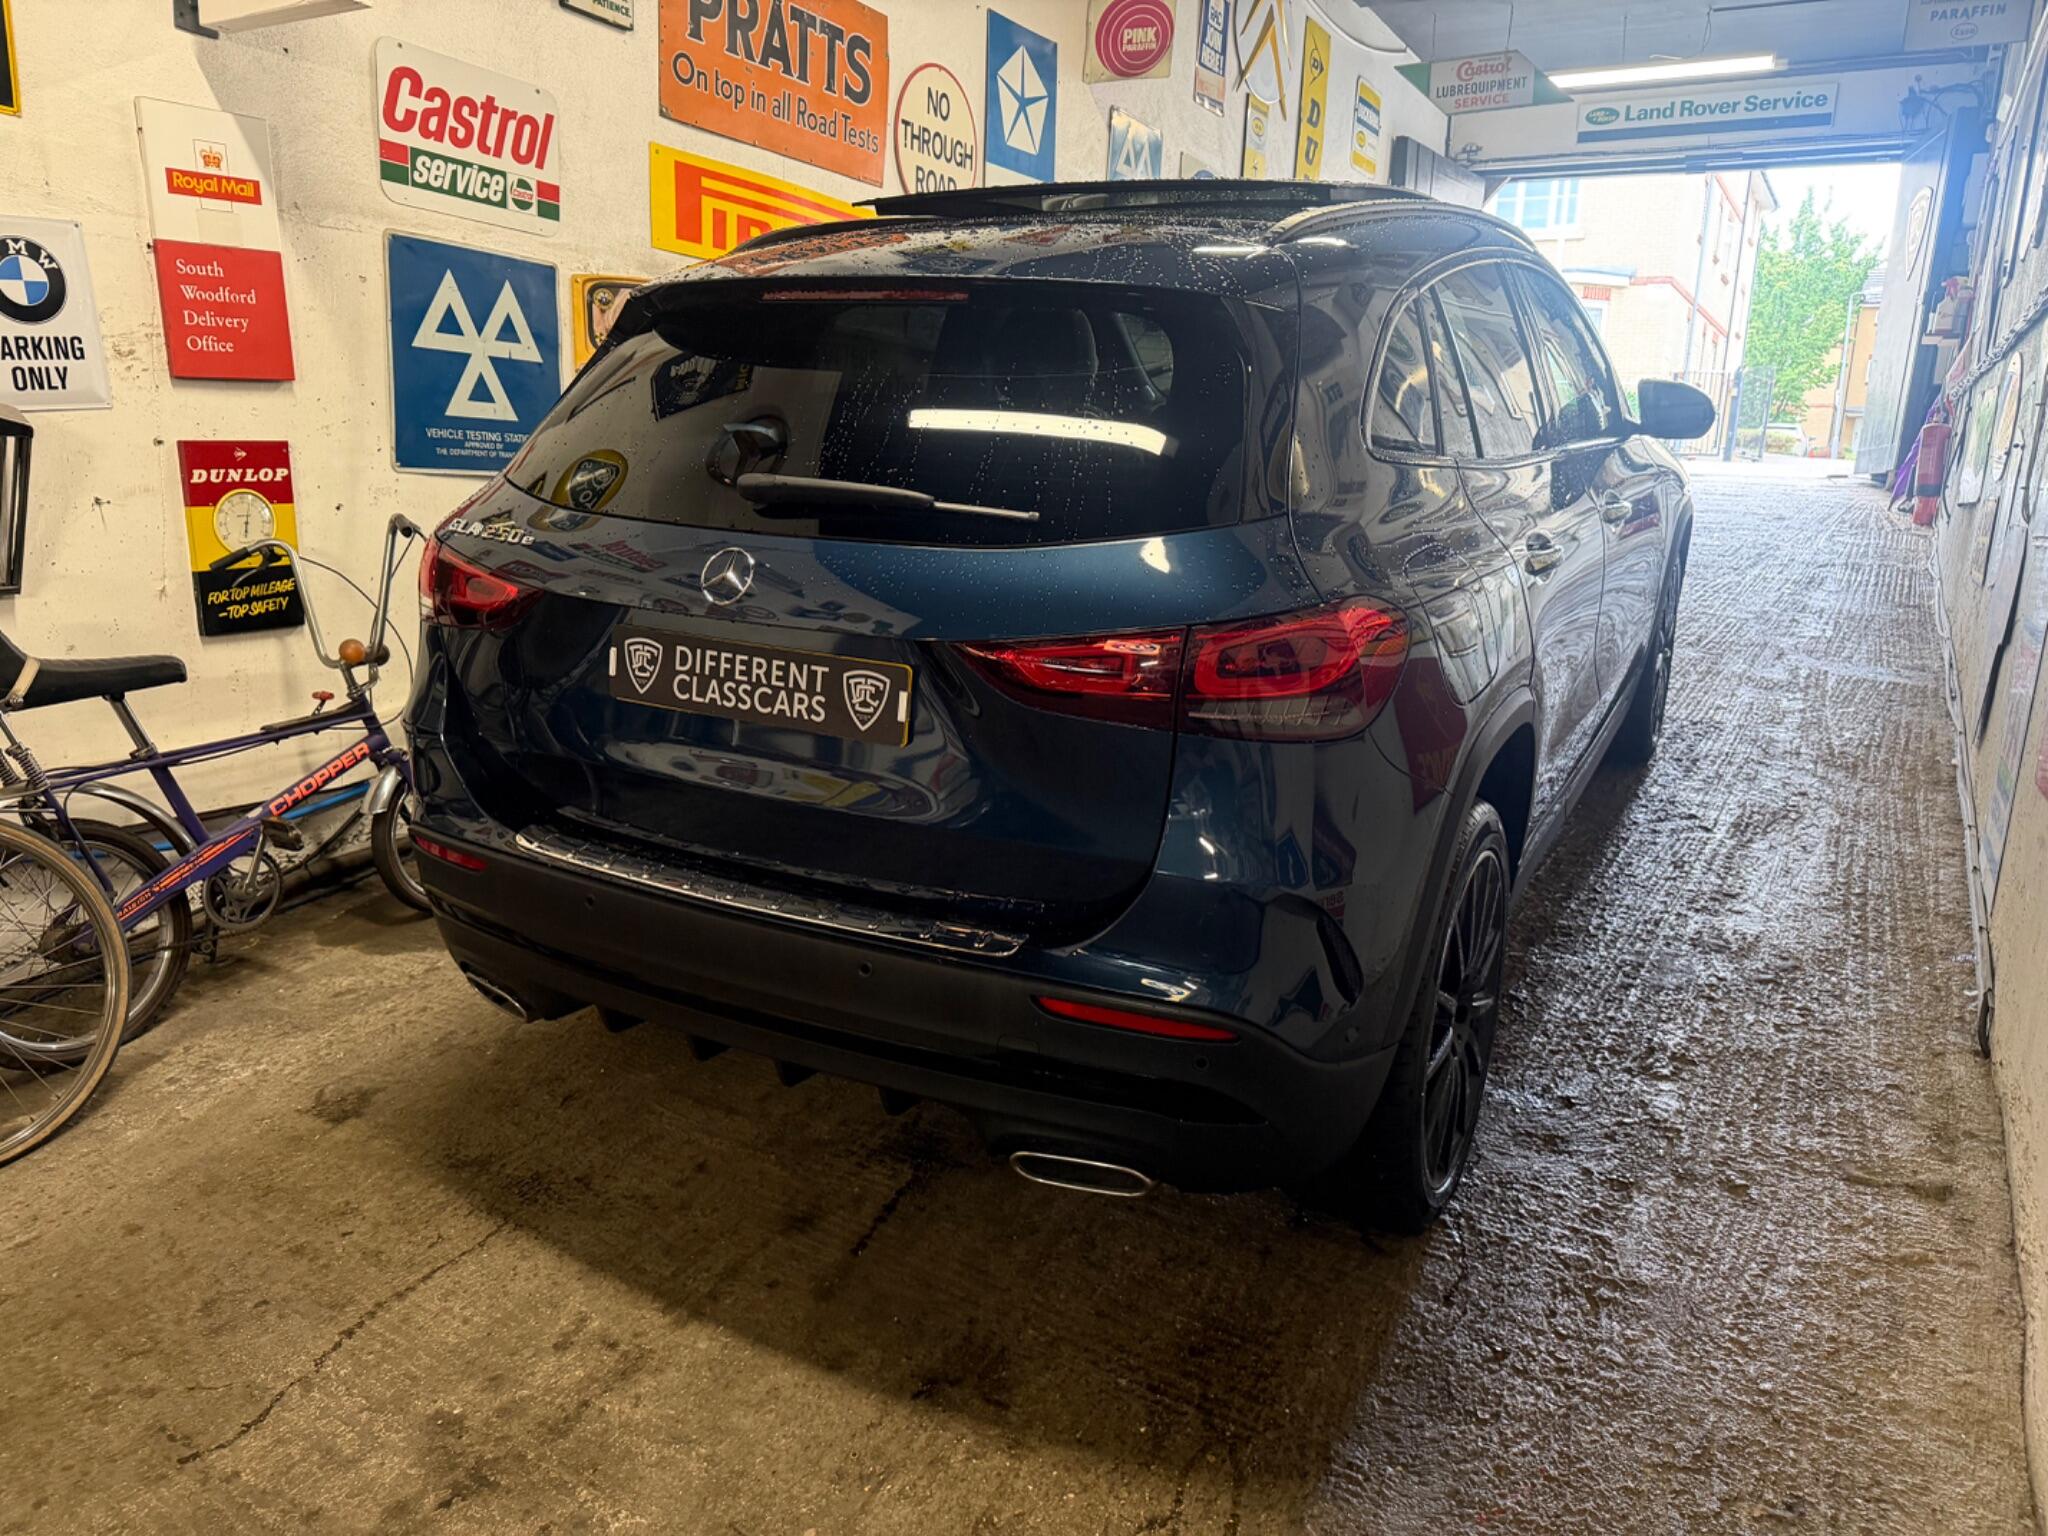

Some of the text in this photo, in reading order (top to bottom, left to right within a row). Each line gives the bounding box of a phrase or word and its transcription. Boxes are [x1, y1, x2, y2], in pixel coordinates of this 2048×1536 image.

[1930, 3, 2007, 21] PARAFFIN
[1122, 26, 1157, 44] PINK
[687, 0, 872, 105] PRATTS
[1456, 55, 1513, 82] Castrol
[1436, 76, 1528, 98] LUBREQUIPMENT
[672, 52, 879, 154] On top in all Road Tests
[927, 86, 950, 121] NO
[1454, 93, 1510, 109] SERVICE
[1624, 91, 1829, 122] Land Rover Service
[383, 66, 554, 170] Castrol
[901, 118, 974, 172] THROUGH
[172, 171, 255, 198] Royal Mail
[413, 154, 505, 202] service
[6, 238, 59, 270] MW
[176, 258, 224, 278] South
[180, 284, 257, 305] Woodford
[183, 310, 249, 333] Delivery
[0, 335, 86, 361] ARKING
[186, 335, 235, 353] Office
[11, 365, 68, 392] ONLY
[425, 427, 464, 440] VEHICLE
[465, 430, 502, 442] TESTING
[464, 440, 495, 450] APPROVED
[449, 448, 488, 458] DEPARTMENT
[488, 450, 497, 458] OF
[190, 468, 289, 484] DUNLOP
[448, 518, 484, 536] GLA
[207, 577, 296, 606] FOR TOP MILEAGE
[249, 596, 289, 617] SAFETY
[674, 645, 830, 693] DIFFERENT
[673, 674, 827, 723] CLASSCARS
[269, 742, 371, 817] CHOPPER
